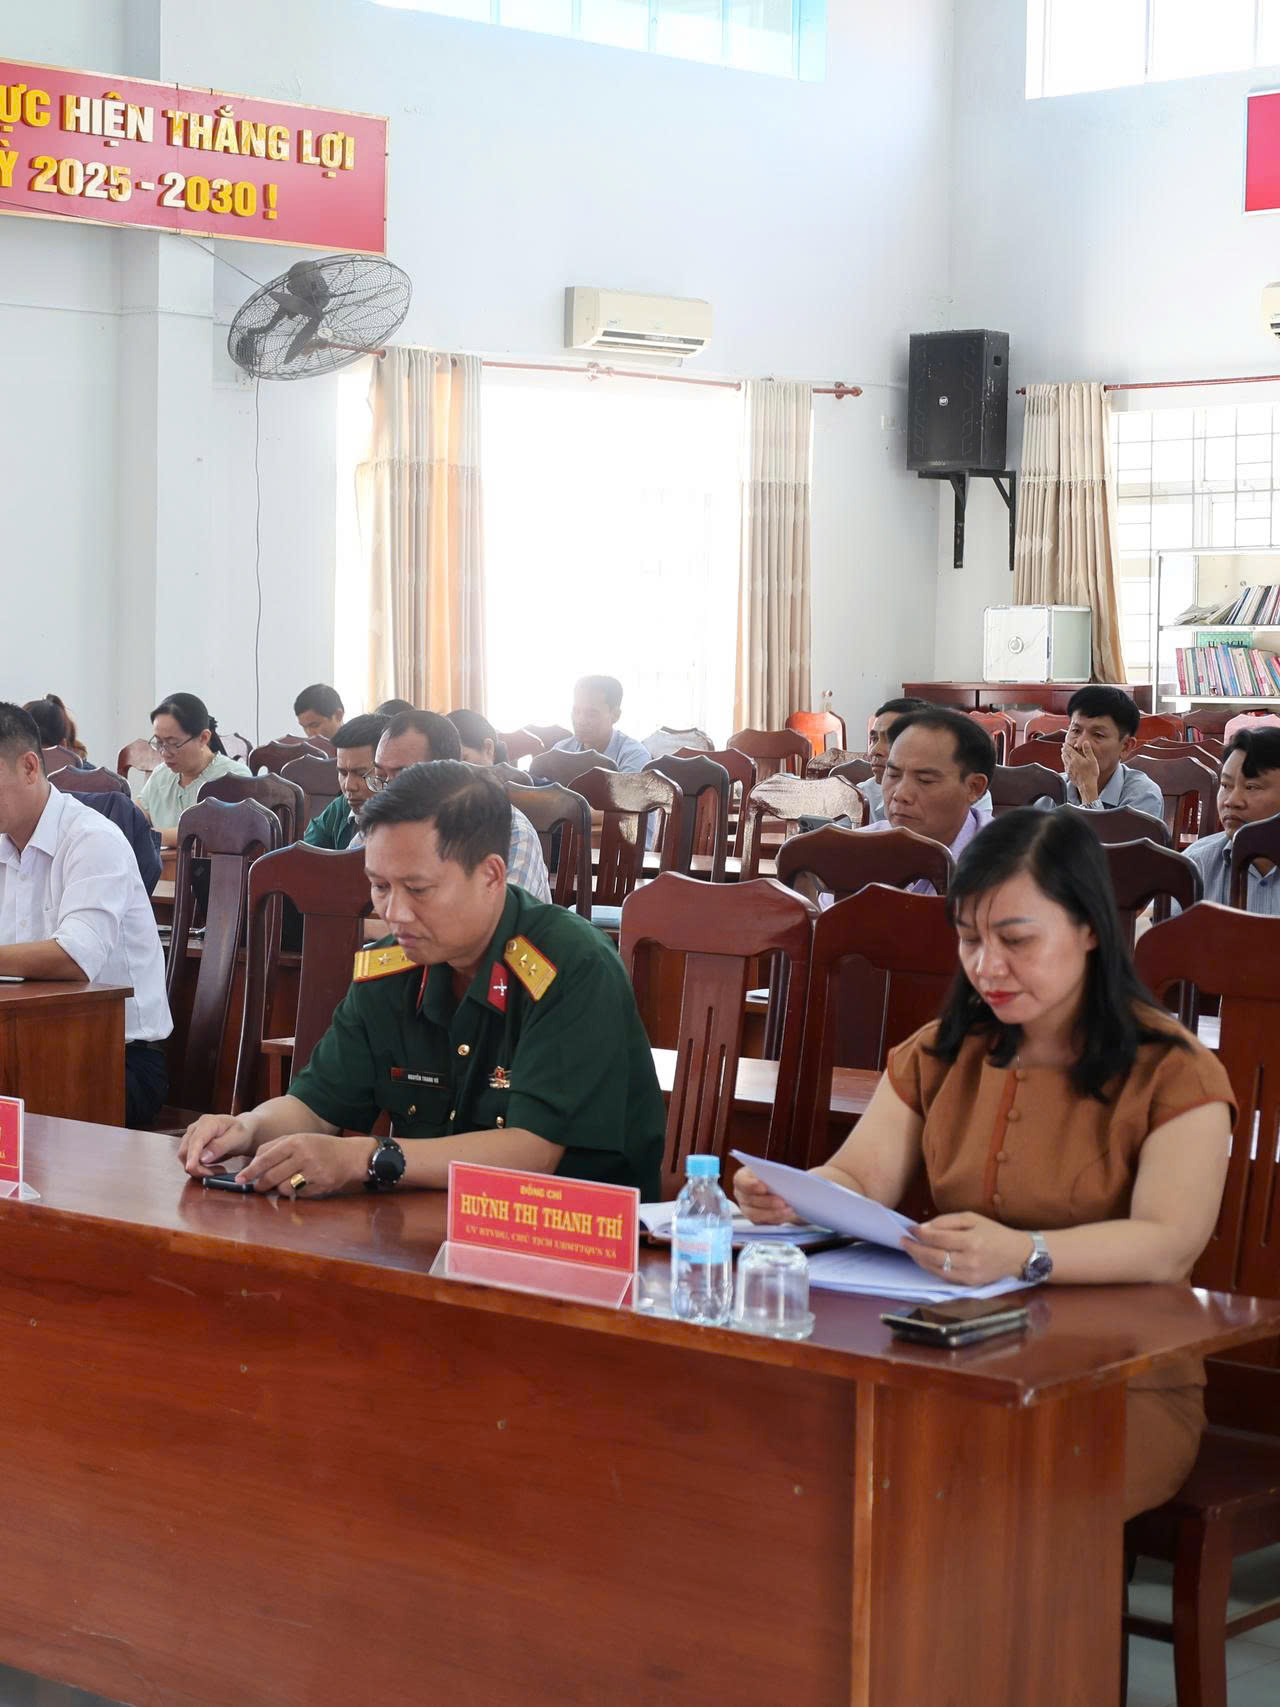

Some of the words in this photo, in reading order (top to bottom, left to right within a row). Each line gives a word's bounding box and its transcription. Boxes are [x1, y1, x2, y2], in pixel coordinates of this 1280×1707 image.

[63, 91, 154, 147] HIỆN
[164, 104, 290, 161] THẮNG
[300, 128, 356, 178] LỢI
[30, 155, 132, 202] 2025
[160, 172, 257, 218] 2030
[264, 184, 279, 221] !
[460, 1192, 510, 1221] HUỲNH
[513, 1203, 539, 1231] THỊ
[543, 1207, 593, 1235] THANH
[520, 1184, 545, 1197] ĐỒNG
